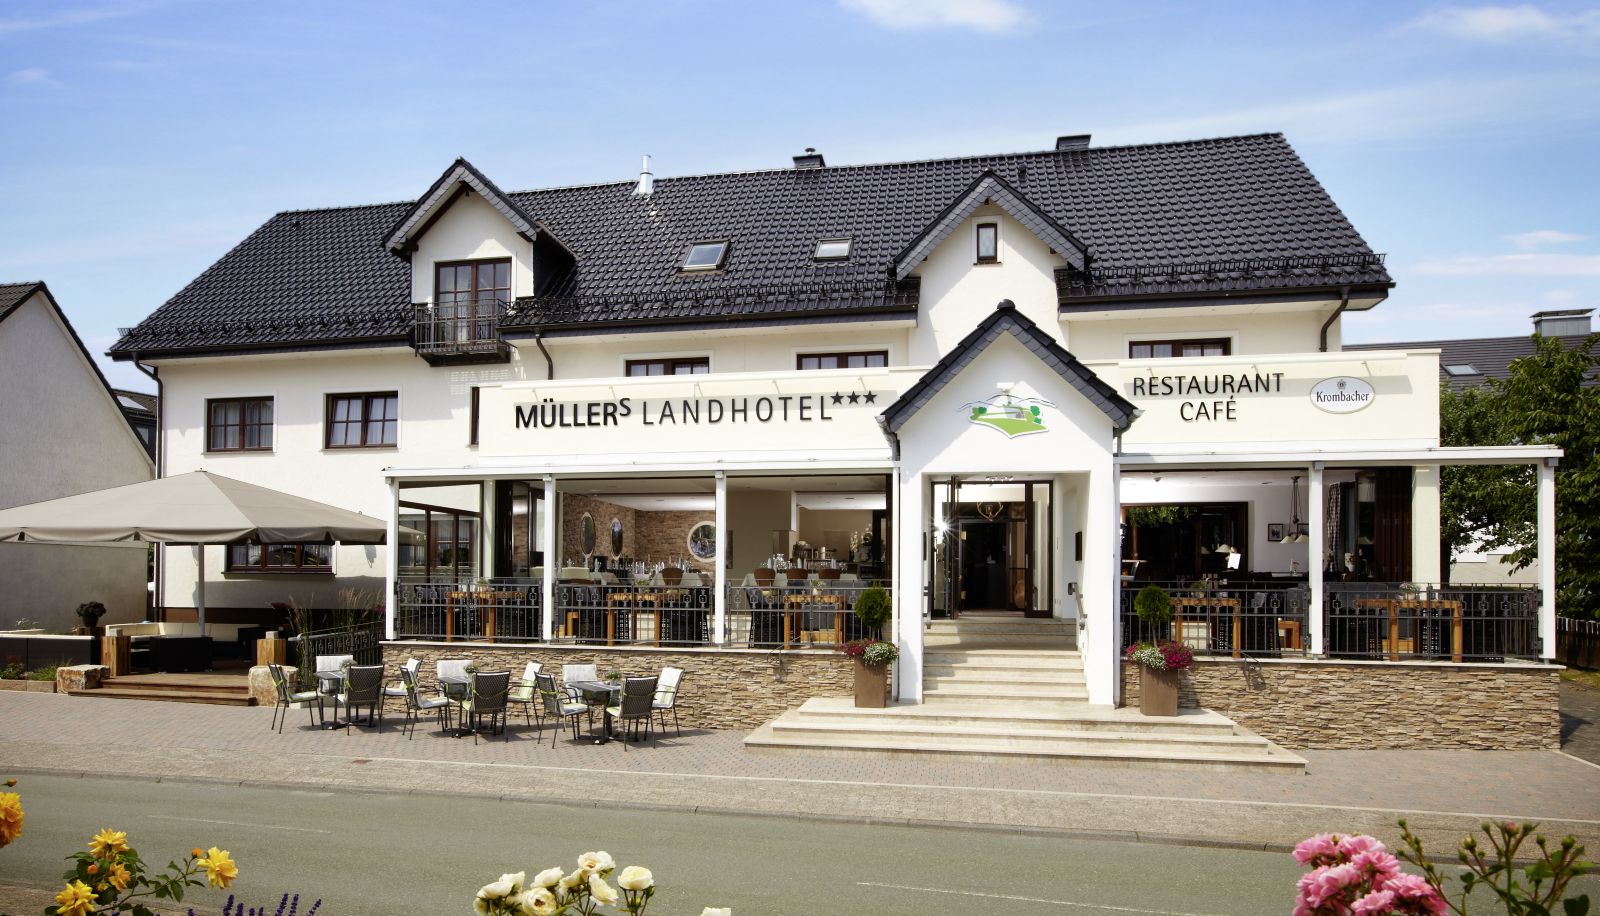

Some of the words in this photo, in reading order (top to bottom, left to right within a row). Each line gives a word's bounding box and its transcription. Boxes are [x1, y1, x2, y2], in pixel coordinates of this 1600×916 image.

[1133, 373, 1284, 396] RESTAURANT
[1316, 391, 1369, 402] Krombacher
[515, 398, 632, 428] MÜLLERS
[642, 395, 833, 425] LANDHOTEL
[1180, 395, 1237, 421] CAFÉ
